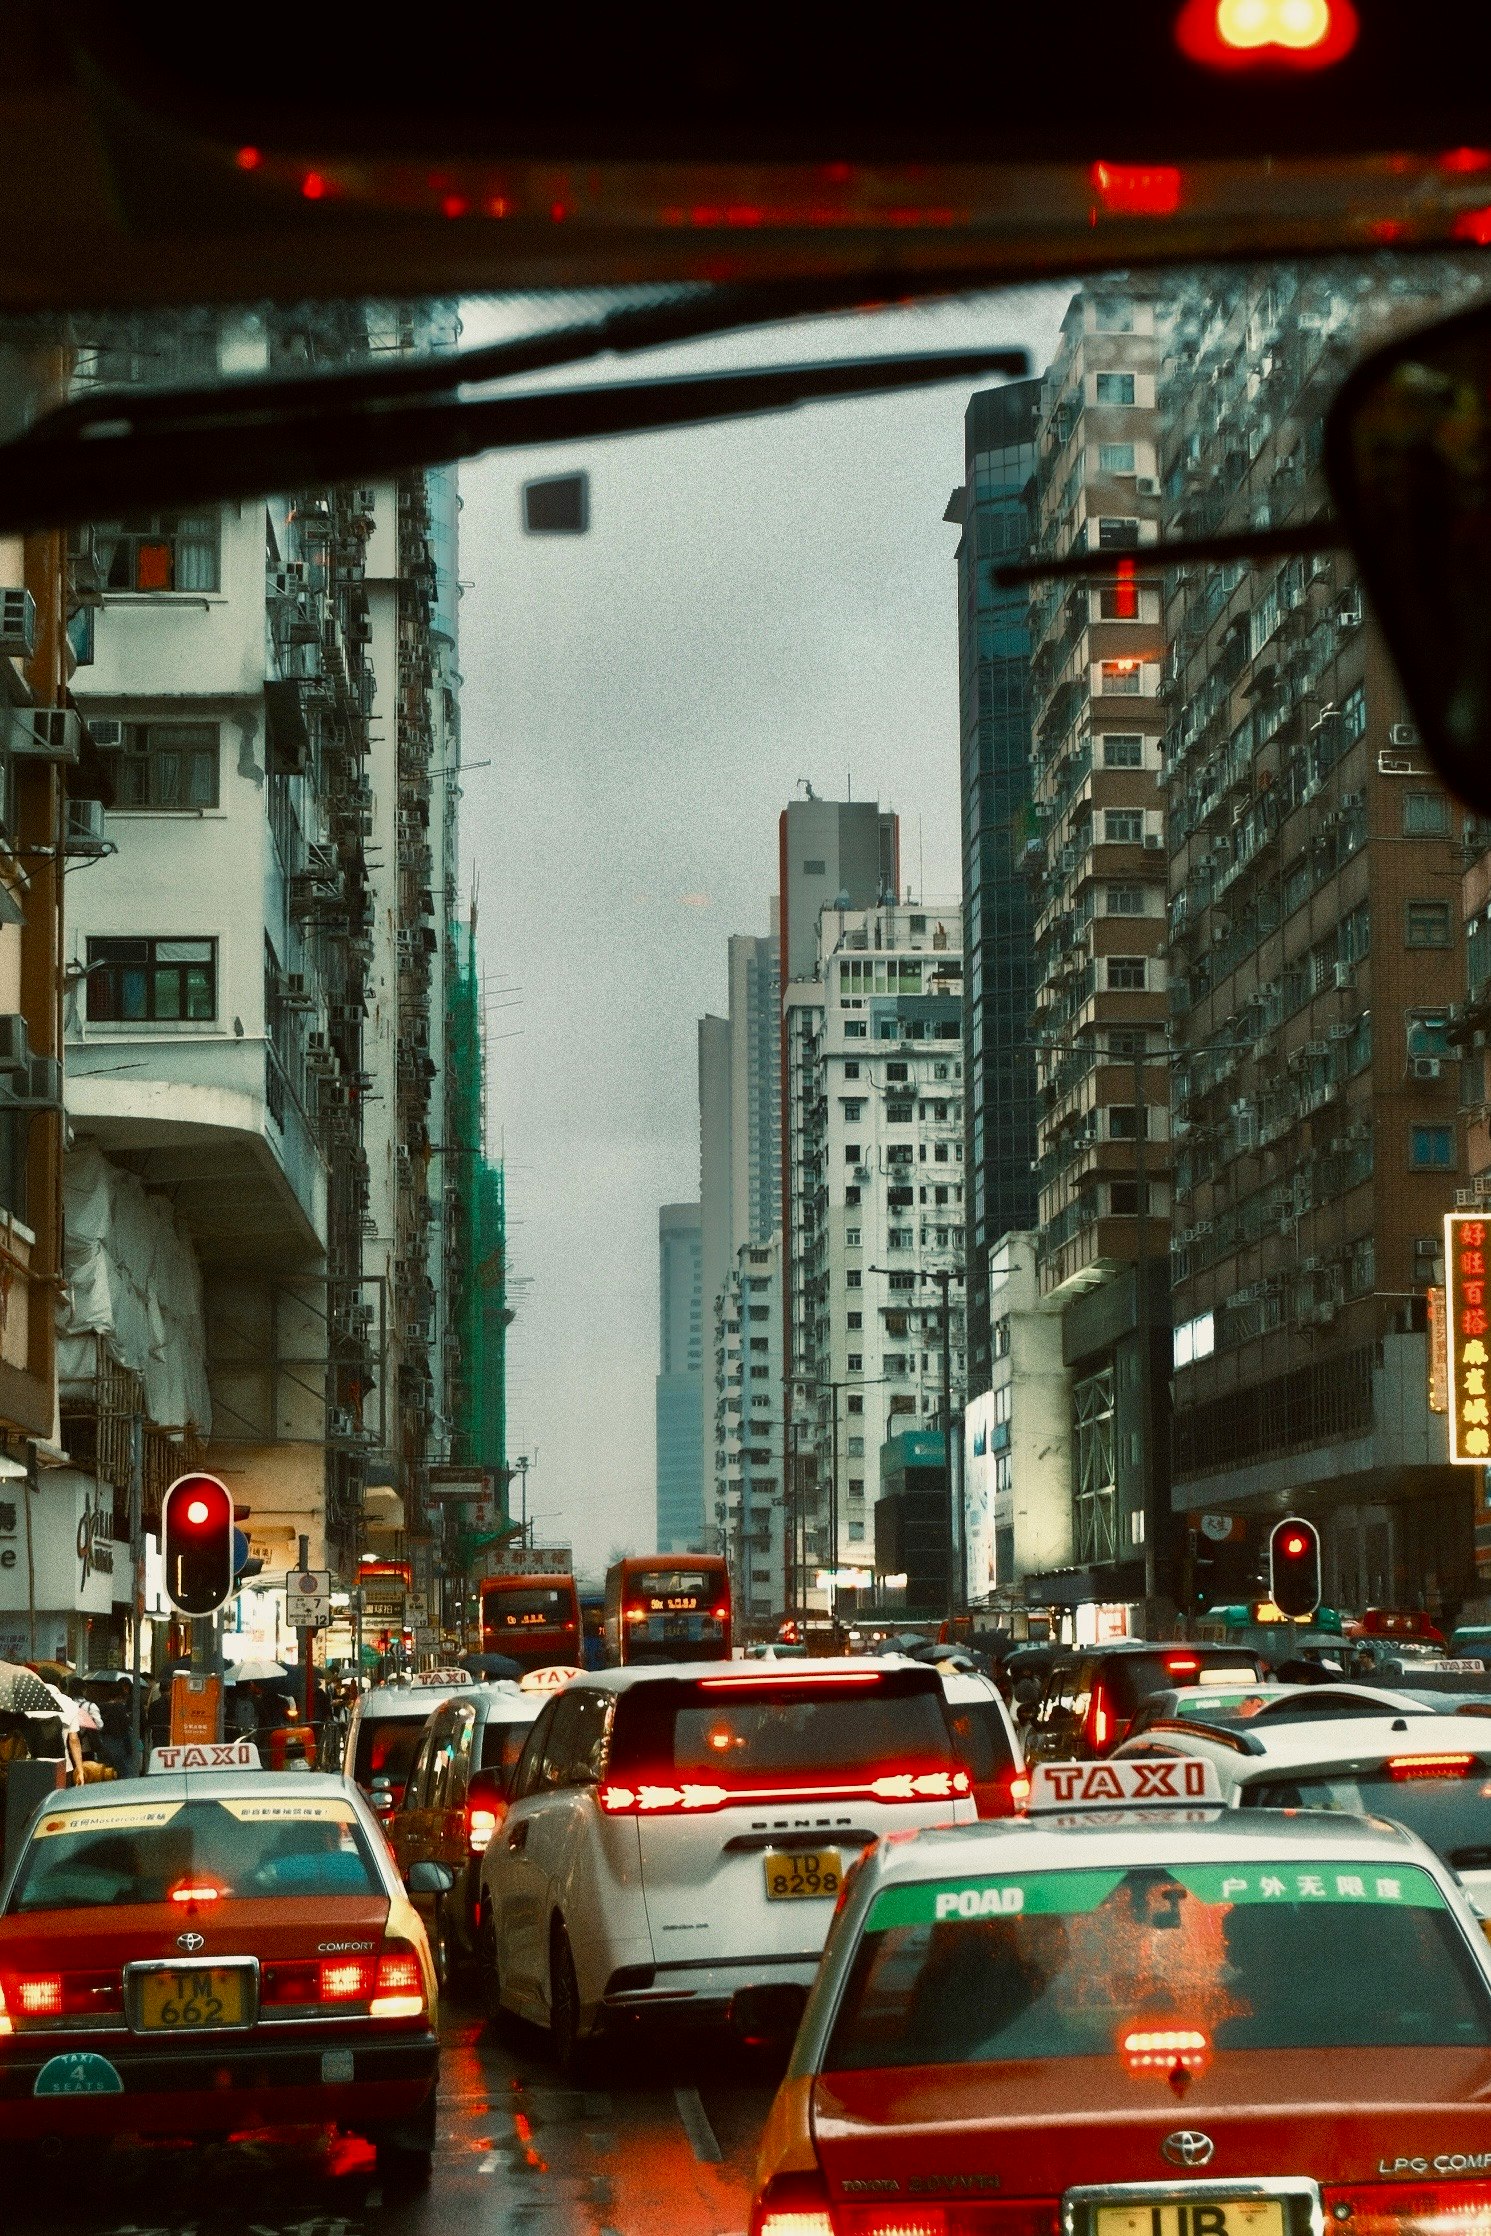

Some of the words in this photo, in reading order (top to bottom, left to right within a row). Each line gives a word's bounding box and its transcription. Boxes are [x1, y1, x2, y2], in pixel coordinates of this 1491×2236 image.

[314, 1614, 327, 1625] 12
[1440, 1661, 1480, 1670] TAXI
[418, 1672, 466, 1685] TAXI
[158, 1745, 250, 1768] TAXI
[1045, 1761, 1206, 1800] TAXI
[788, 1855, 820, 1874] TD
[773, 1873, 838, 1893] 8298
[935, 1887, 1025, 1919] POAD
[317, 1941, 376, 1952] COMFORT
[174, 1973, 214, 1999] TM
[161, 2001, 224, 2025] 662
[60, 2054, 95, 2064] TAXI
[70, 2064, 86, 2081] 4
[53, 2082, 104, 2091] SEATS
[1378, 2157, 1428, 2175] LPG
